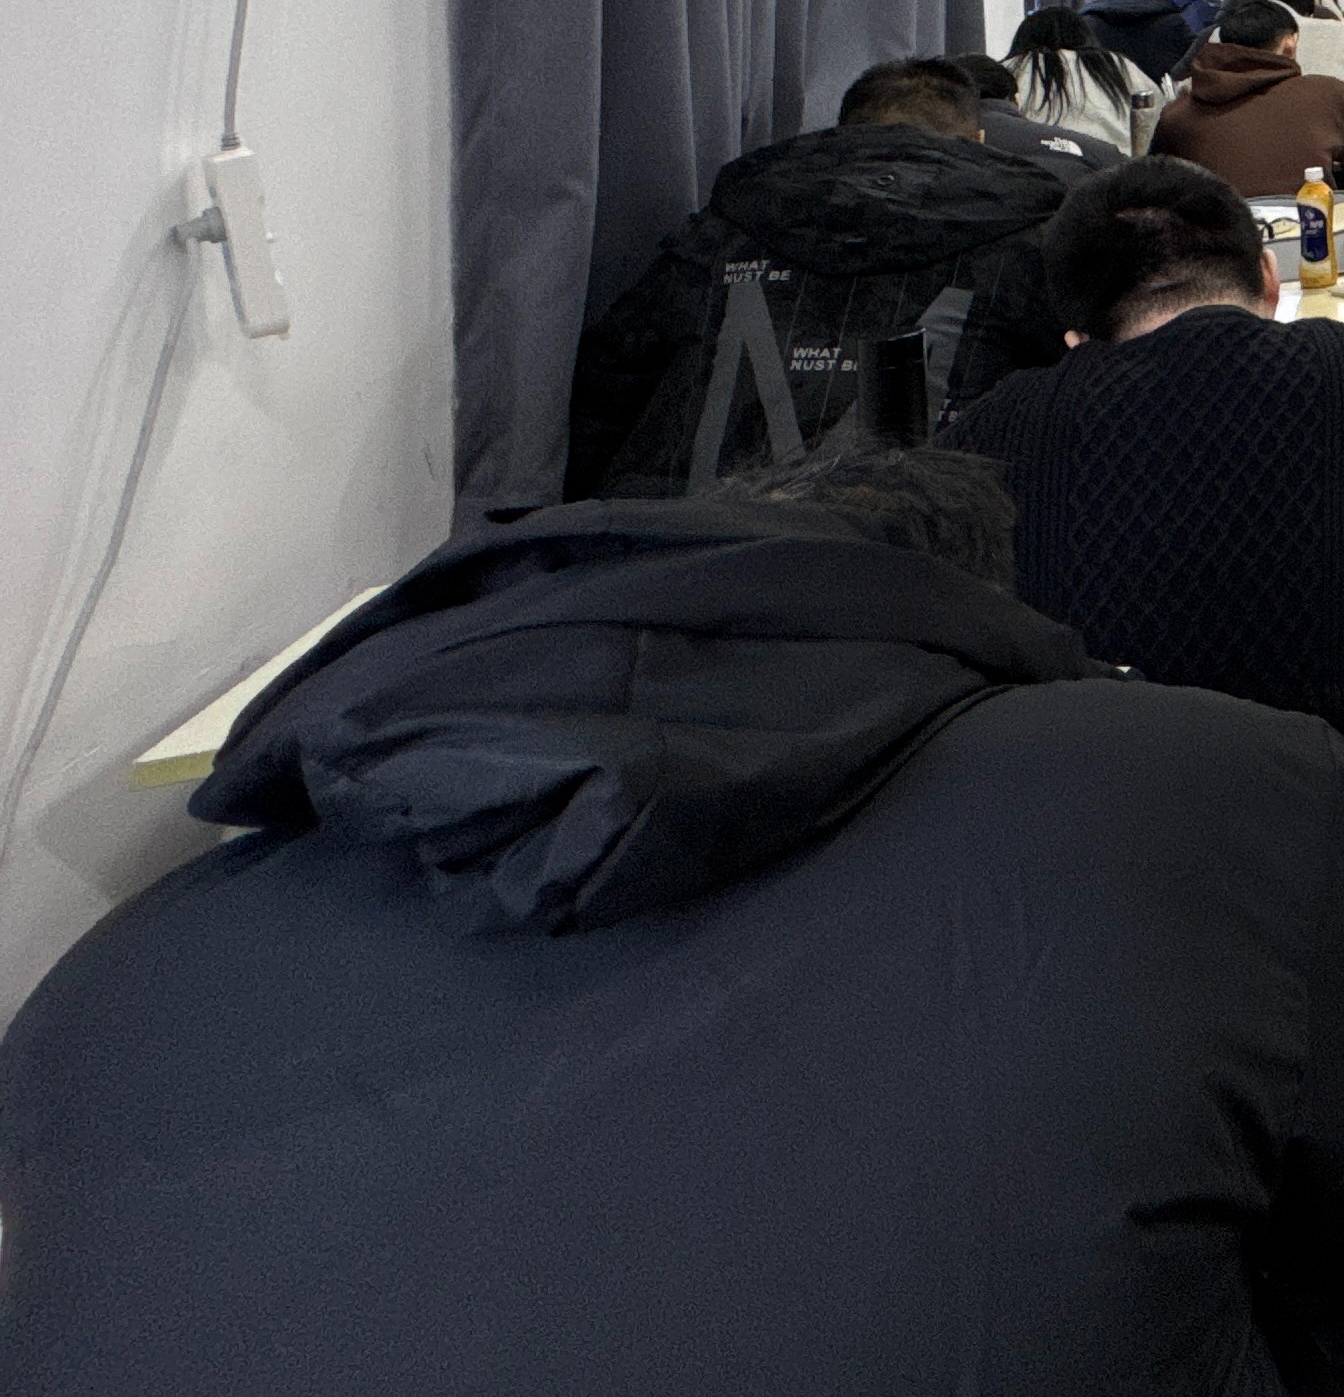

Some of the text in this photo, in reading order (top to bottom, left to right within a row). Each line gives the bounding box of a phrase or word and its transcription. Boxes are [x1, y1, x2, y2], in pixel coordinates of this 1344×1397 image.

[767, 269, 792, 282] BE
[793, 347, 842, 359] WHAT
[840, 359, 858, 371] B
